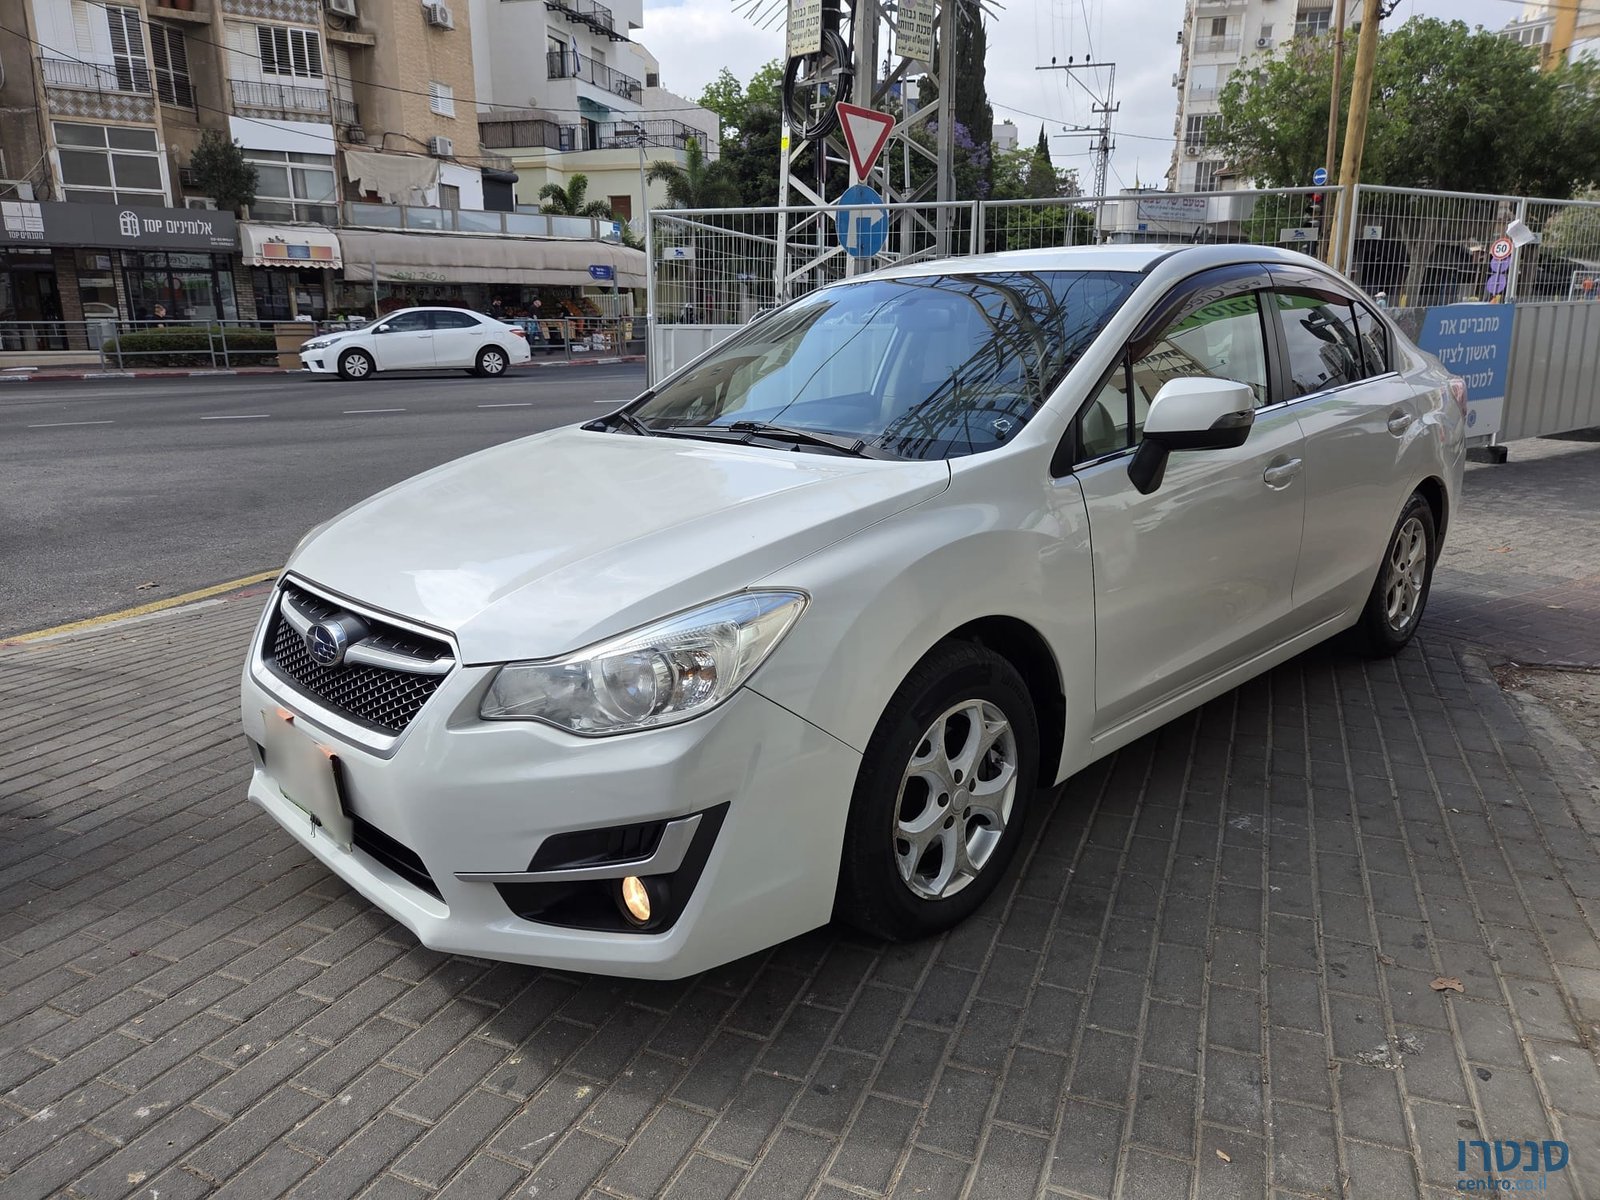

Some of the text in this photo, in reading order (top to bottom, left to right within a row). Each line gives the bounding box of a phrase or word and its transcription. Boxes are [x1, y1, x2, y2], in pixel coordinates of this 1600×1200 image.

[9, 231, 19, 239] TOP
[143, 219, 213, 235] אלומיניום TOP
[1496, 244, 1507, 253] 50
[1440, 317, 1500, 335] מחברים את
[1465, 344, 1496, 365] ראשון
[1462, 368, 1493, 389] למטר
